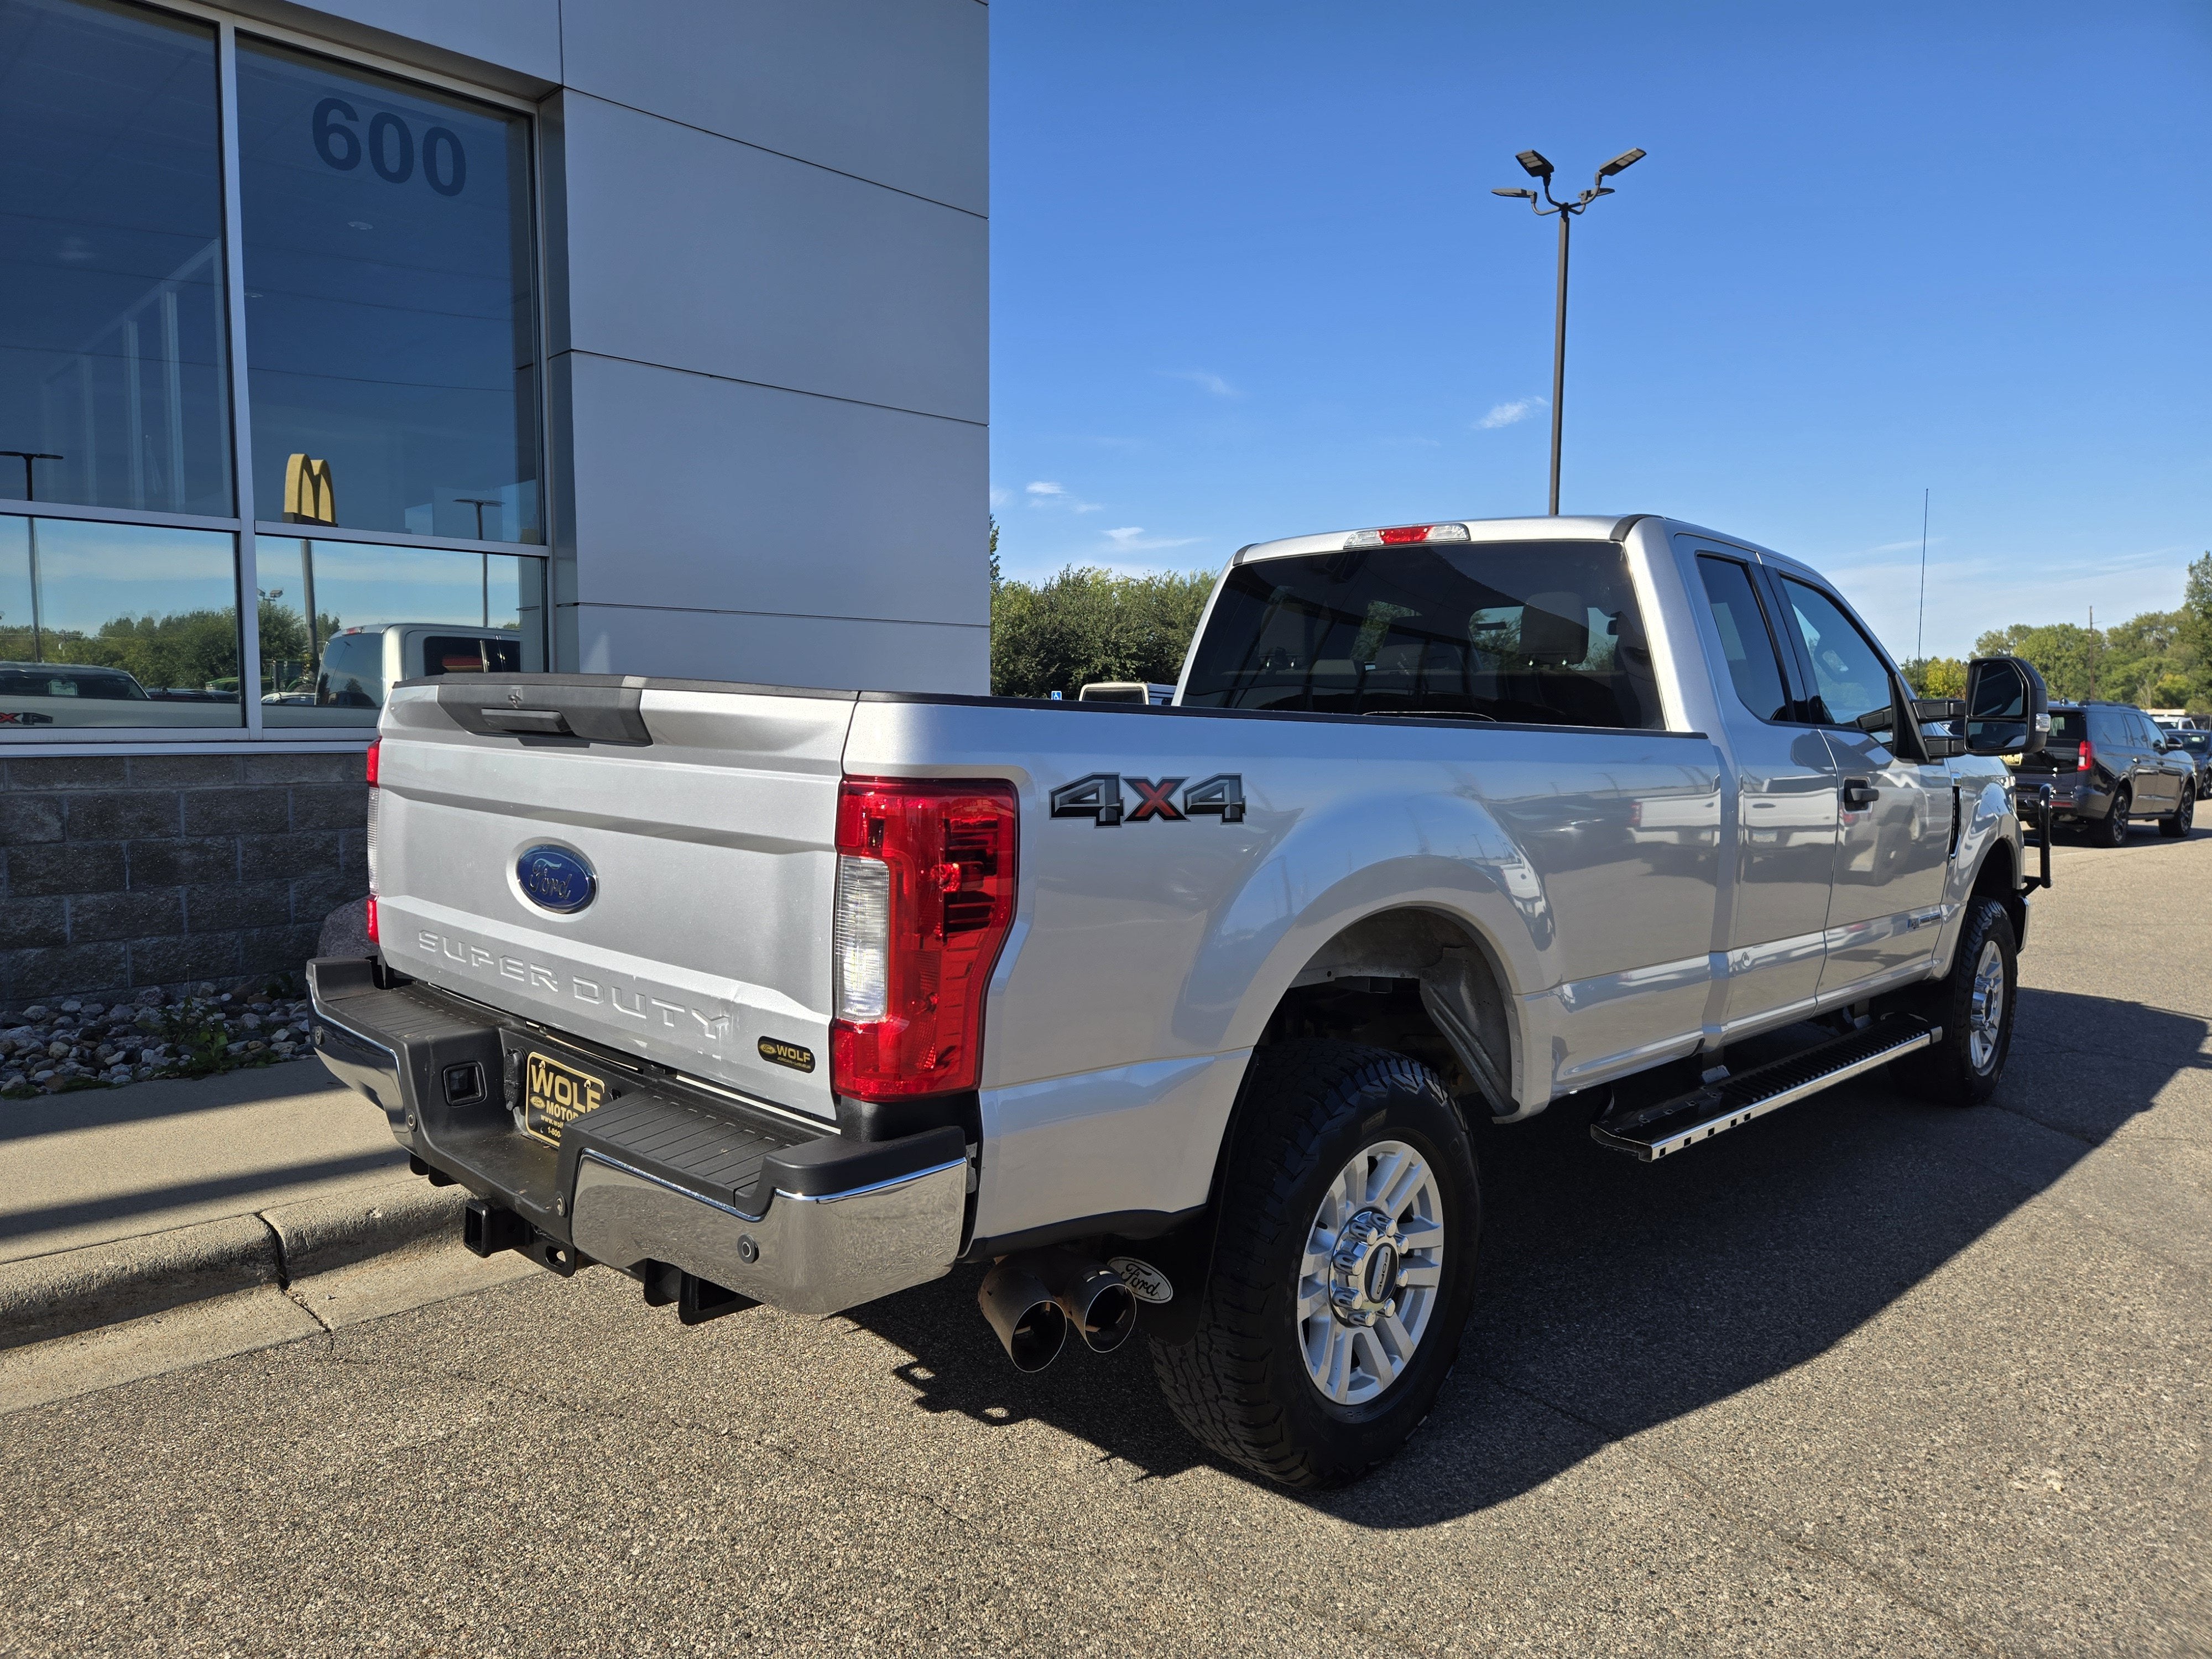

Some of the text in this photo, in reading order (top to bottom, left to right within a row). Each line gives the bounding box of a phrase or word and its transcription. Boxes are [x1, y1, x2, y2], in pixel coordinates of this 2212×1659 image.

[312, 97, 466, 196] 600
[1049, 773, 1246, 828] 4X4
[529, 858, 572, 899] Ford
[419, 930, 729, 1040] SUPER DUTY
[776, 1045, 811, 1063] WOLF
[531, 1065, 601, 1113] WOLF
[1120, 1263, 1161, 1296] Ford
[1377, 1252, 1389, 1295] FORD
